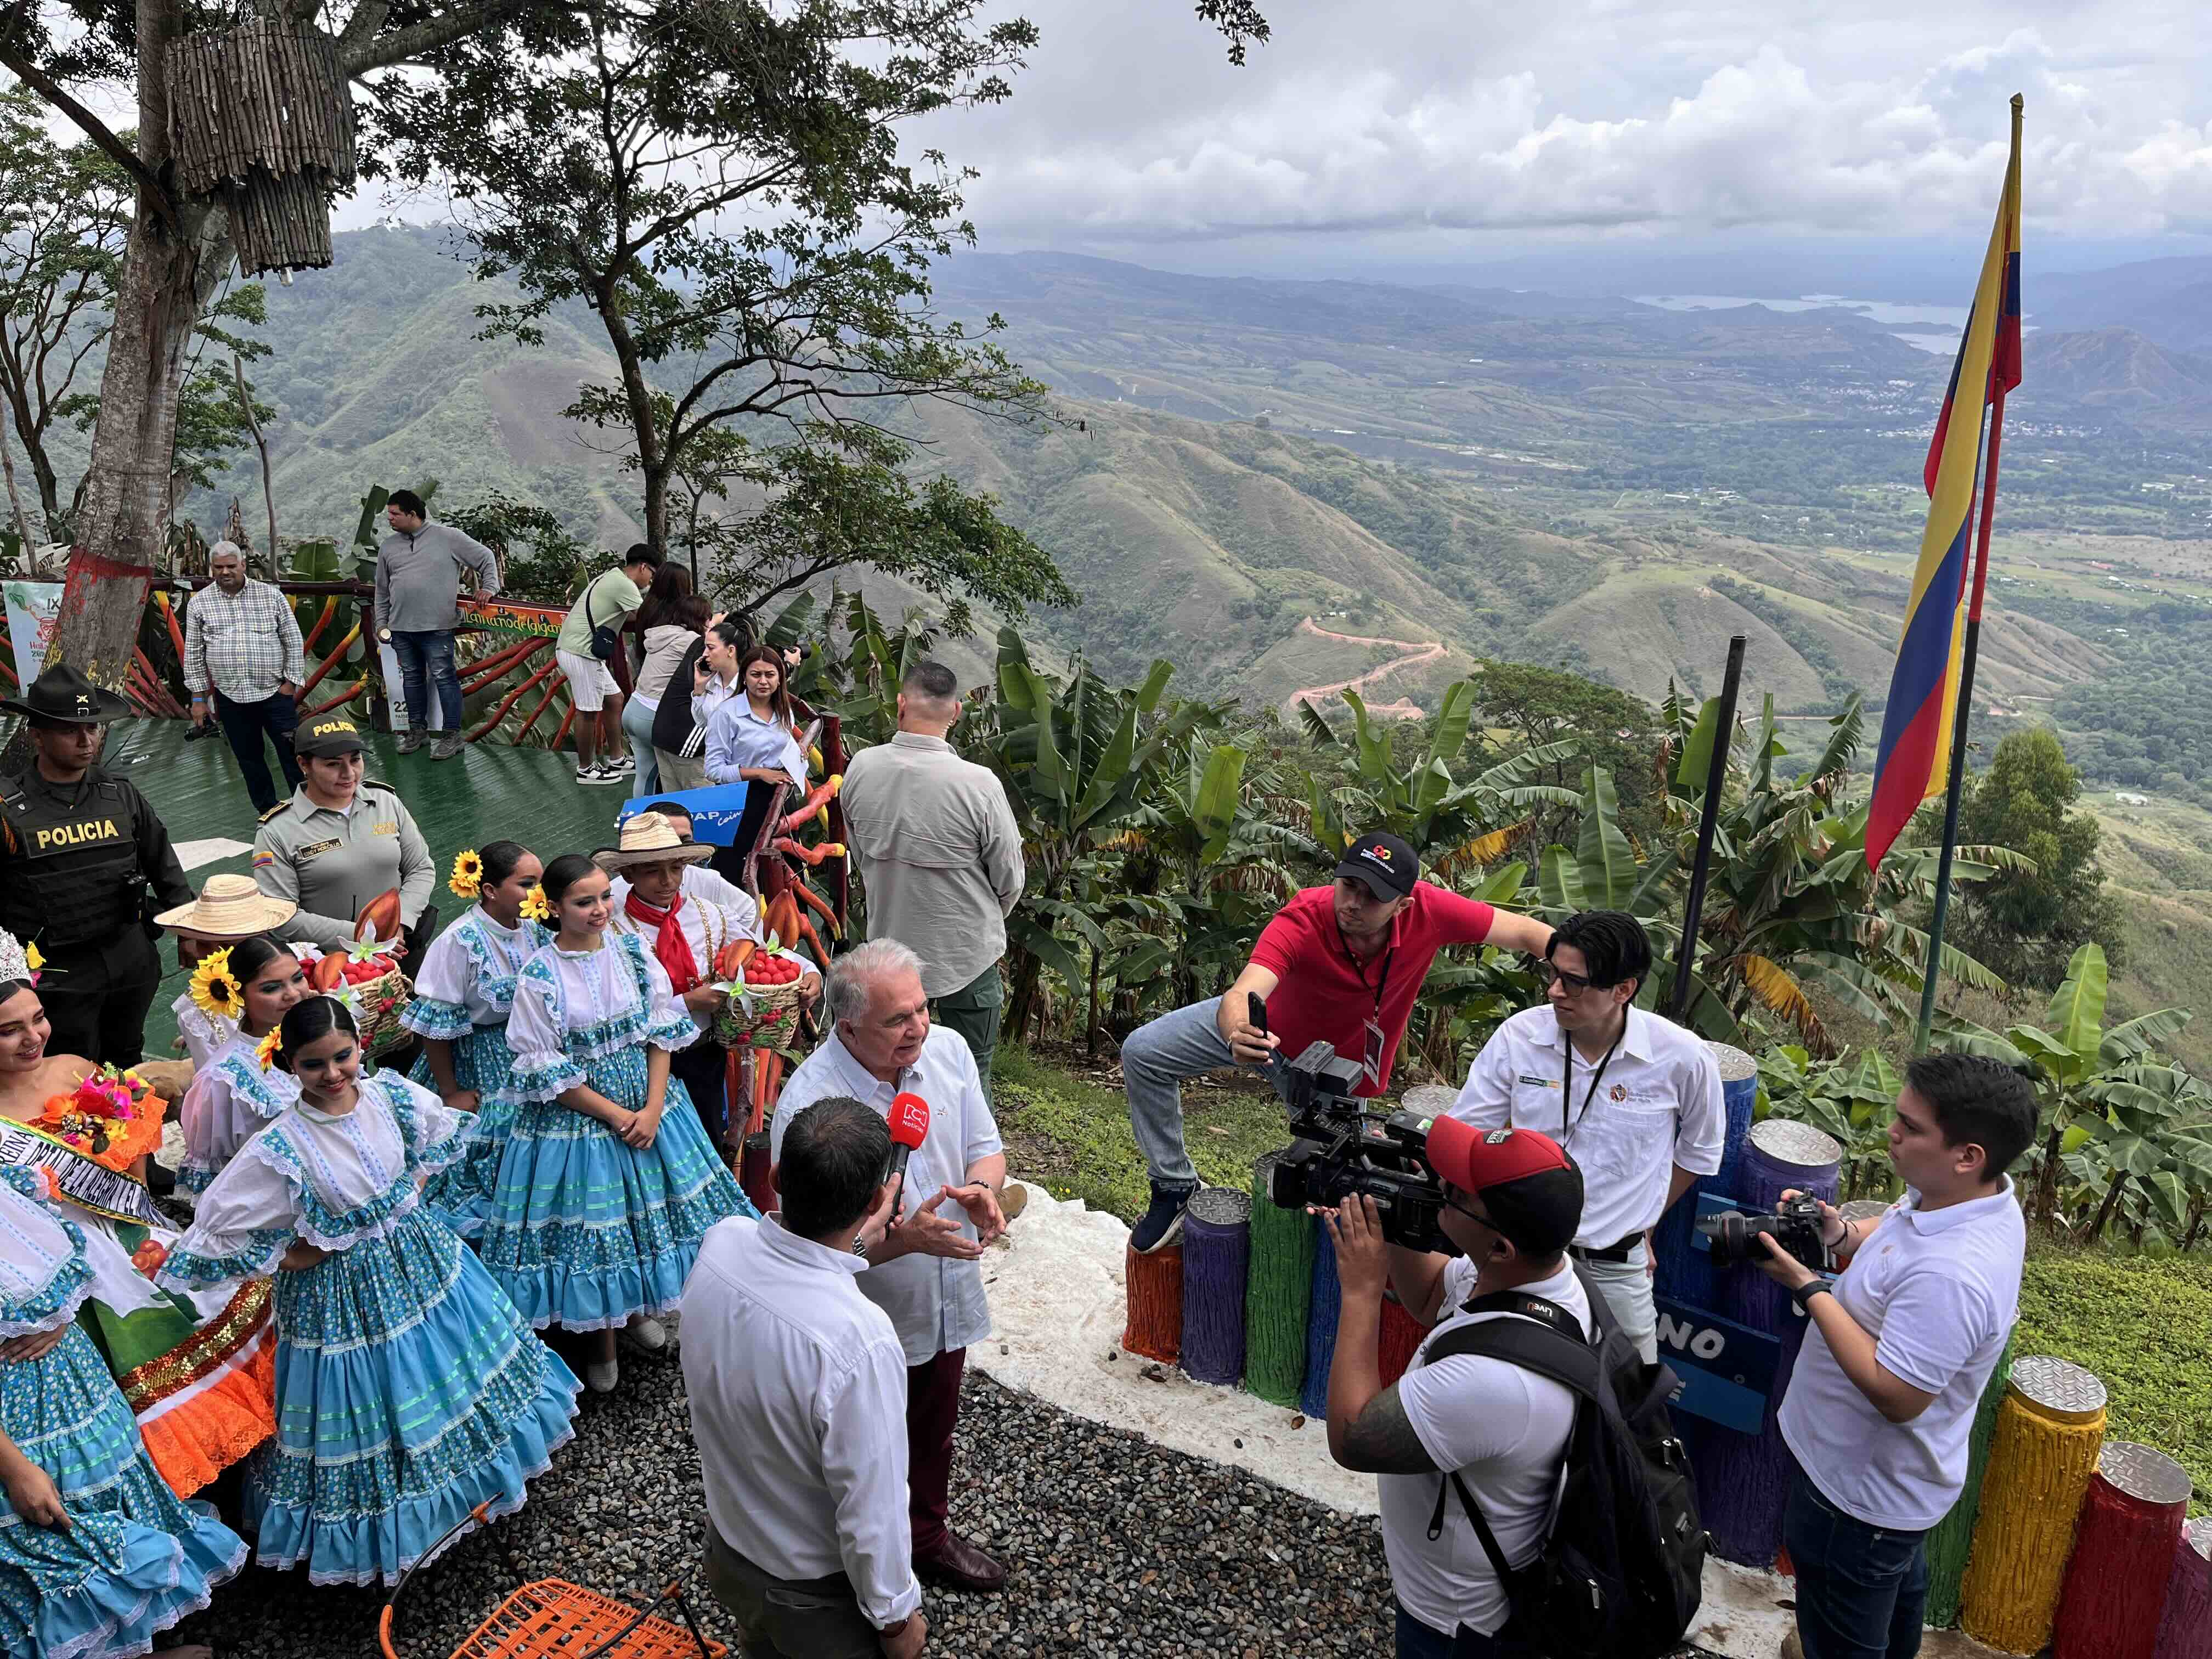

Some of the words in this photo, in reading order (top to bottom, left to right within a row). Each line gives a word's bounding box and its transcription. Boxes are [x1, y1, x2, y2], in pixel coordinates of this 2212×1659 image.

[529, 622, 562, 637] gigan
[37, 820, 119, 849] POLICIA
[902, 1120, 924, 1133] Noticias
[58, 1155, 83, 1188] DE
[68, 1162, 95, 1196] LA
